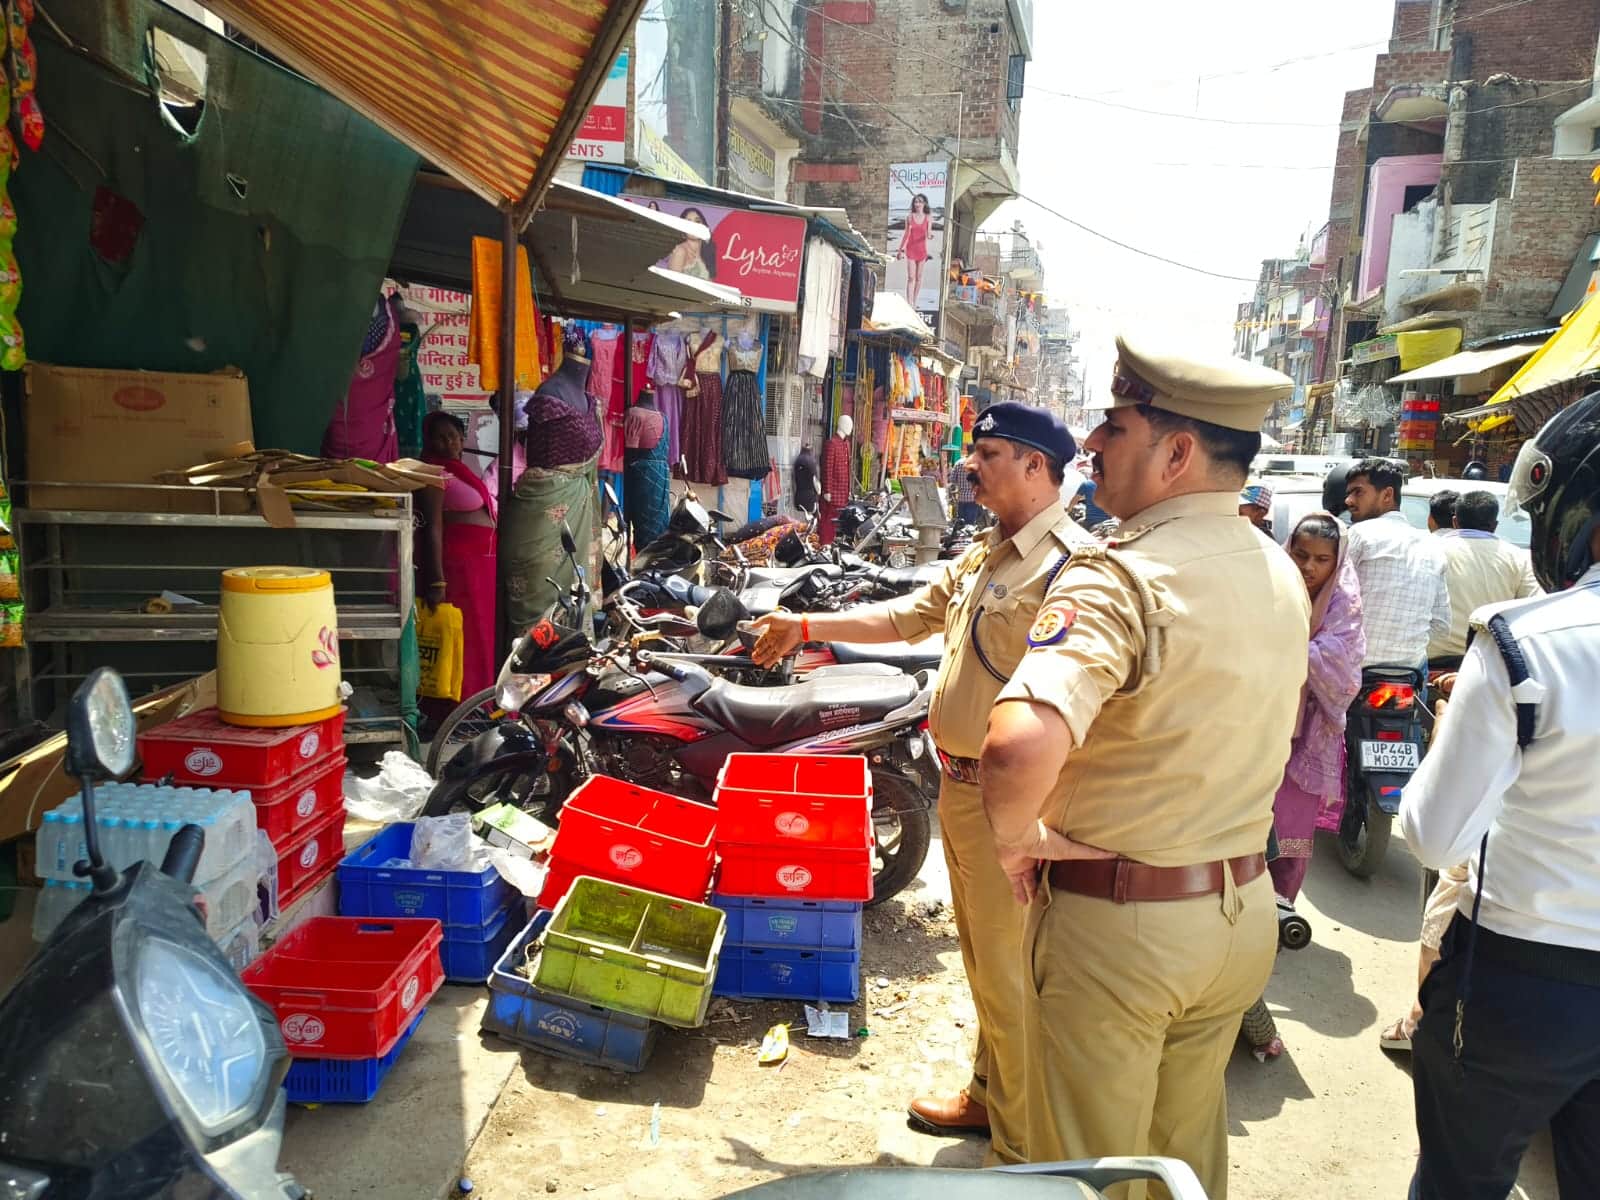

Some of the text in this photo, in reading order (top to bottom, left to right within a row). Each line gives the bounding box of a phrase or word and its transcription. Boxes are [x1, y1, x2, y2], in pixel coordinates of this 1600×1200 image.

[721, 232, 787, 276] Lyra
[1375, 755, 1414, 766] M0374
[286, 1018, 320, 1037] Gyan
